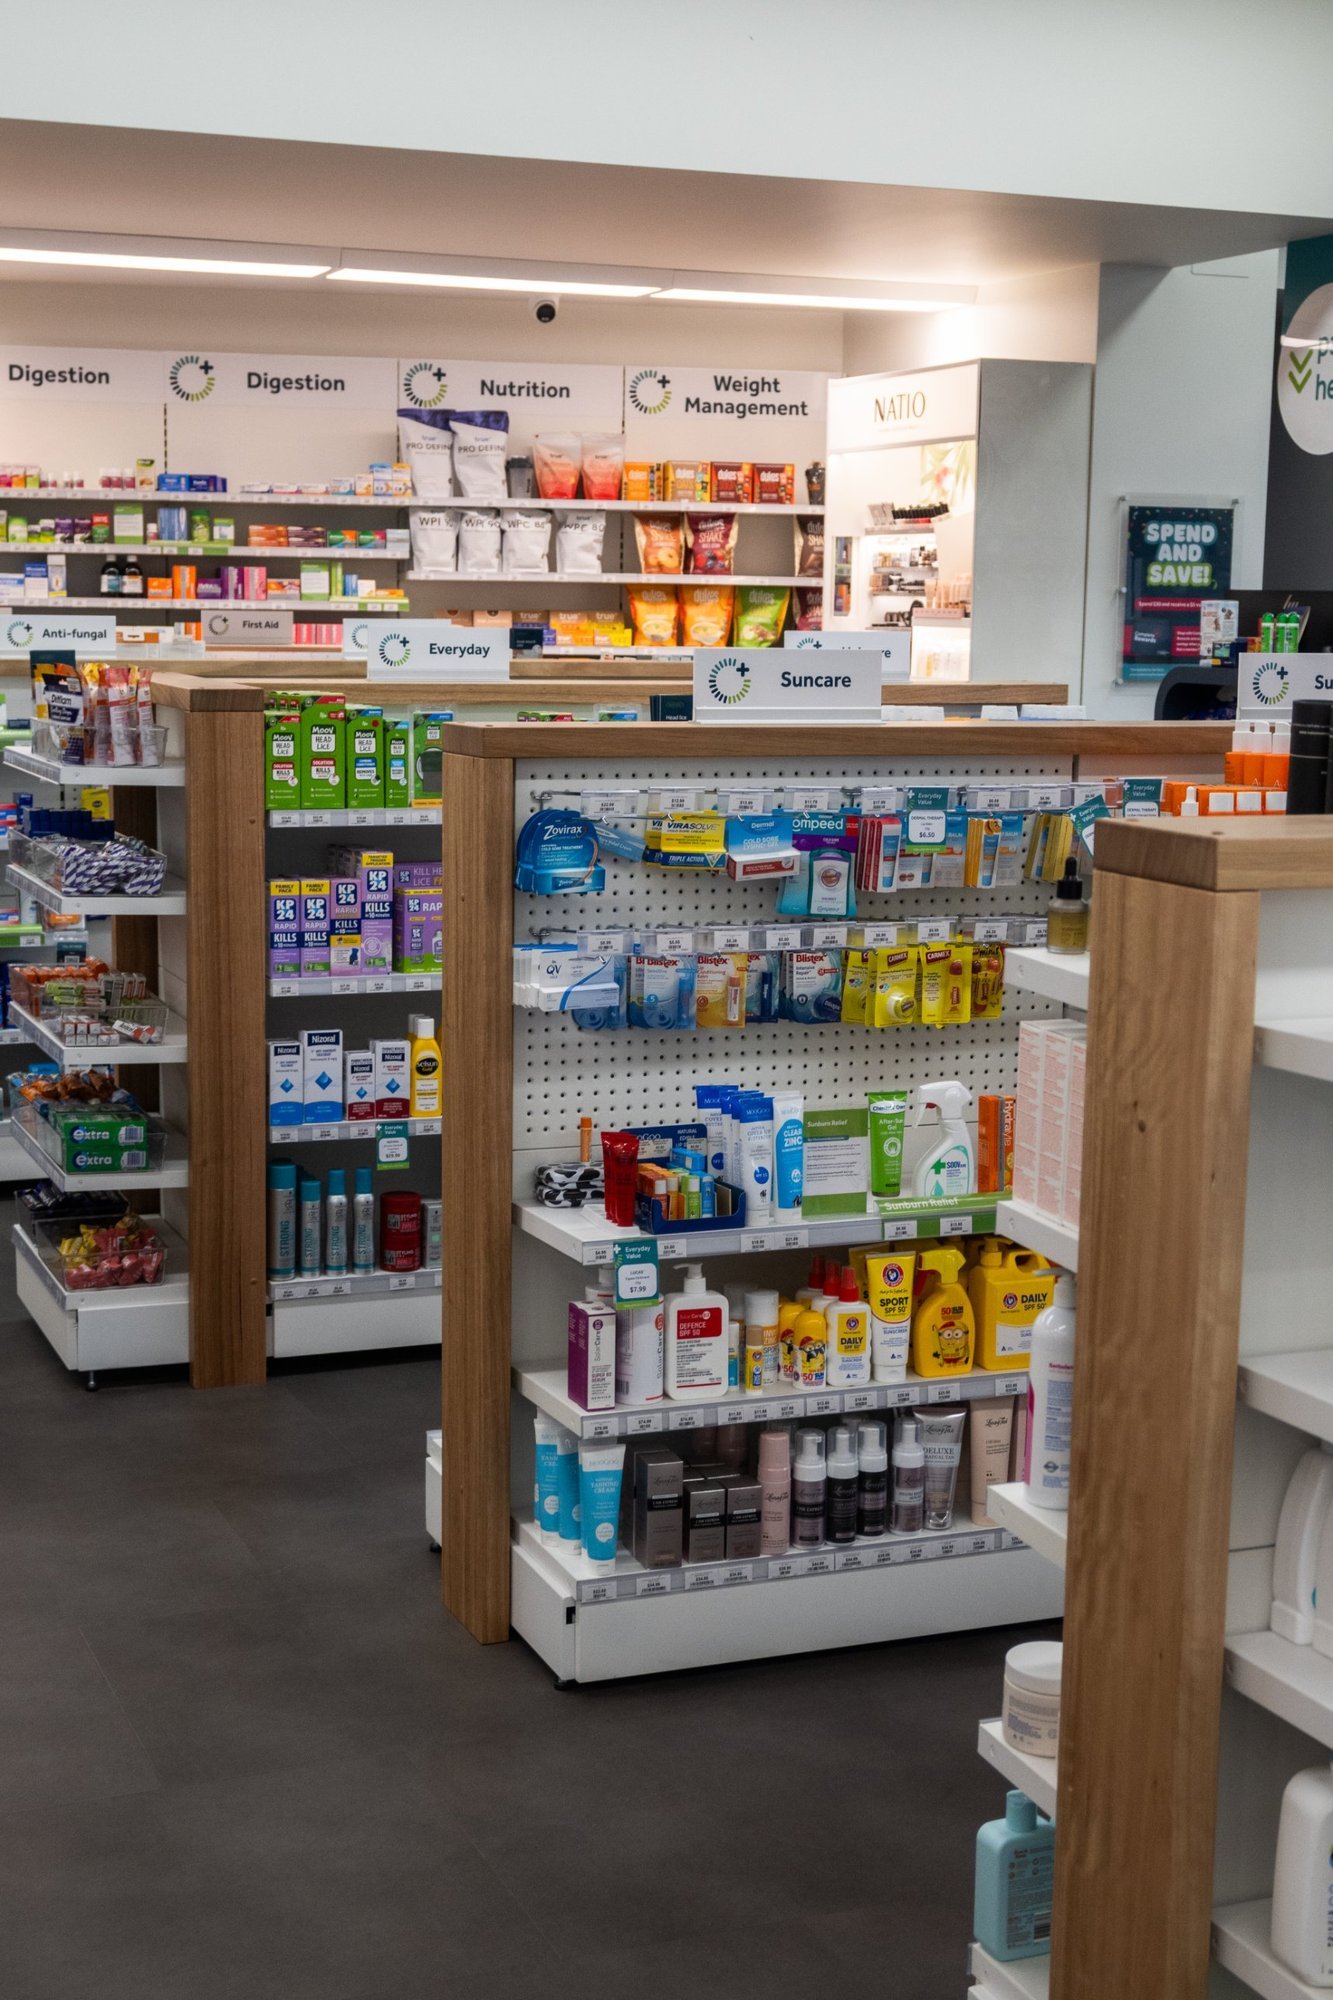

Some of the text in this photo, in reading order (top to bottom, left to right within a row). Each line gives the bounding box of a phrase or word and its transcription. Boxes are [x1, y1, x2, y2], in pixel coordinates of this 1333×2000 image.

[8, 364, 110, 386] Digestion
[247, 372, 345, 394] Digestion
[480, 379, 570, 398] Nutrition
[713, 374, 780, 396] Weight
[684, 397, 808, 418] Management
[874, 391, 926, 422] NATIO
[1147, 523, 1216, 543] SPEND
[1158, 544, 1202, 562] AND
[1149, 565, 1210, 584] SAVE!
[242, 620, 279, 629] First Aid
[42, 628, 107, 641] Anti-fungal
[429, 642, 490, 658] Everyday
[781, 671, 851, 687] Suncare
[667, 822, 718, 830] VIRASOLVE
[751, 821, 775, 829] Dermal
[792, 817, 844, 832] ompeed
[543, 825, 582, 840] Zovirax
[919, 831, 935, 839] $6.50
[668, 855, 705, 863] TRIPLE ACTION
[369, 870, 387, 880] KP
[369, 880, 387, 891] 24
[413, 878, 430, 886] LICE
[338, 884, 356, 894] KP
[306, 898, 325, 909] KP
[338, 893, 356, 904] 24
[276, 899, 295, 910] KP
[365, 902, 390, 912] KILLS
[276, 909, 295, 920] 24
[307, 908, 325, 919] 24
[335, 919, 358, 929] KILLS
[273, 932, 297, 942] KILLS
[304, 932, 327, 941] KILLS
[697, 956, 728, 967] Blistex
[795, 953, 825, 964] Blistex
[888, 953, 908, 964] CARMEX
[926, 952, 951, 960] CARMEX
[546, 964, 561, 975] QV
[311, 1034, 336, 1044] Nizoral
[353, 1065, 371, 1073] Nizoral
[1004, 1099, 1014, 1147] Hydralyte
[73, 1129, 110, 1140] extra
[75, 1154, 112, 1166] extra
[885, 1198, 959, 1211] Sunburn Relief
[279, 1220, 290, 1257] STRONG
[304, 1228, 313, 1258] STRONG
[331, 1225, 340, 1257] STRONG
[357, 1224, 366, 1255] STRONG
[880, 1297, 909, 1307] SPORT
[1021, 1293, 1048, 1304] DAILY
[680, 1322, 707, 1330] DEFENCE
[840, 1337, 864, 1345] DAILY
[923, 1447, 955, 1455] DELUXE
